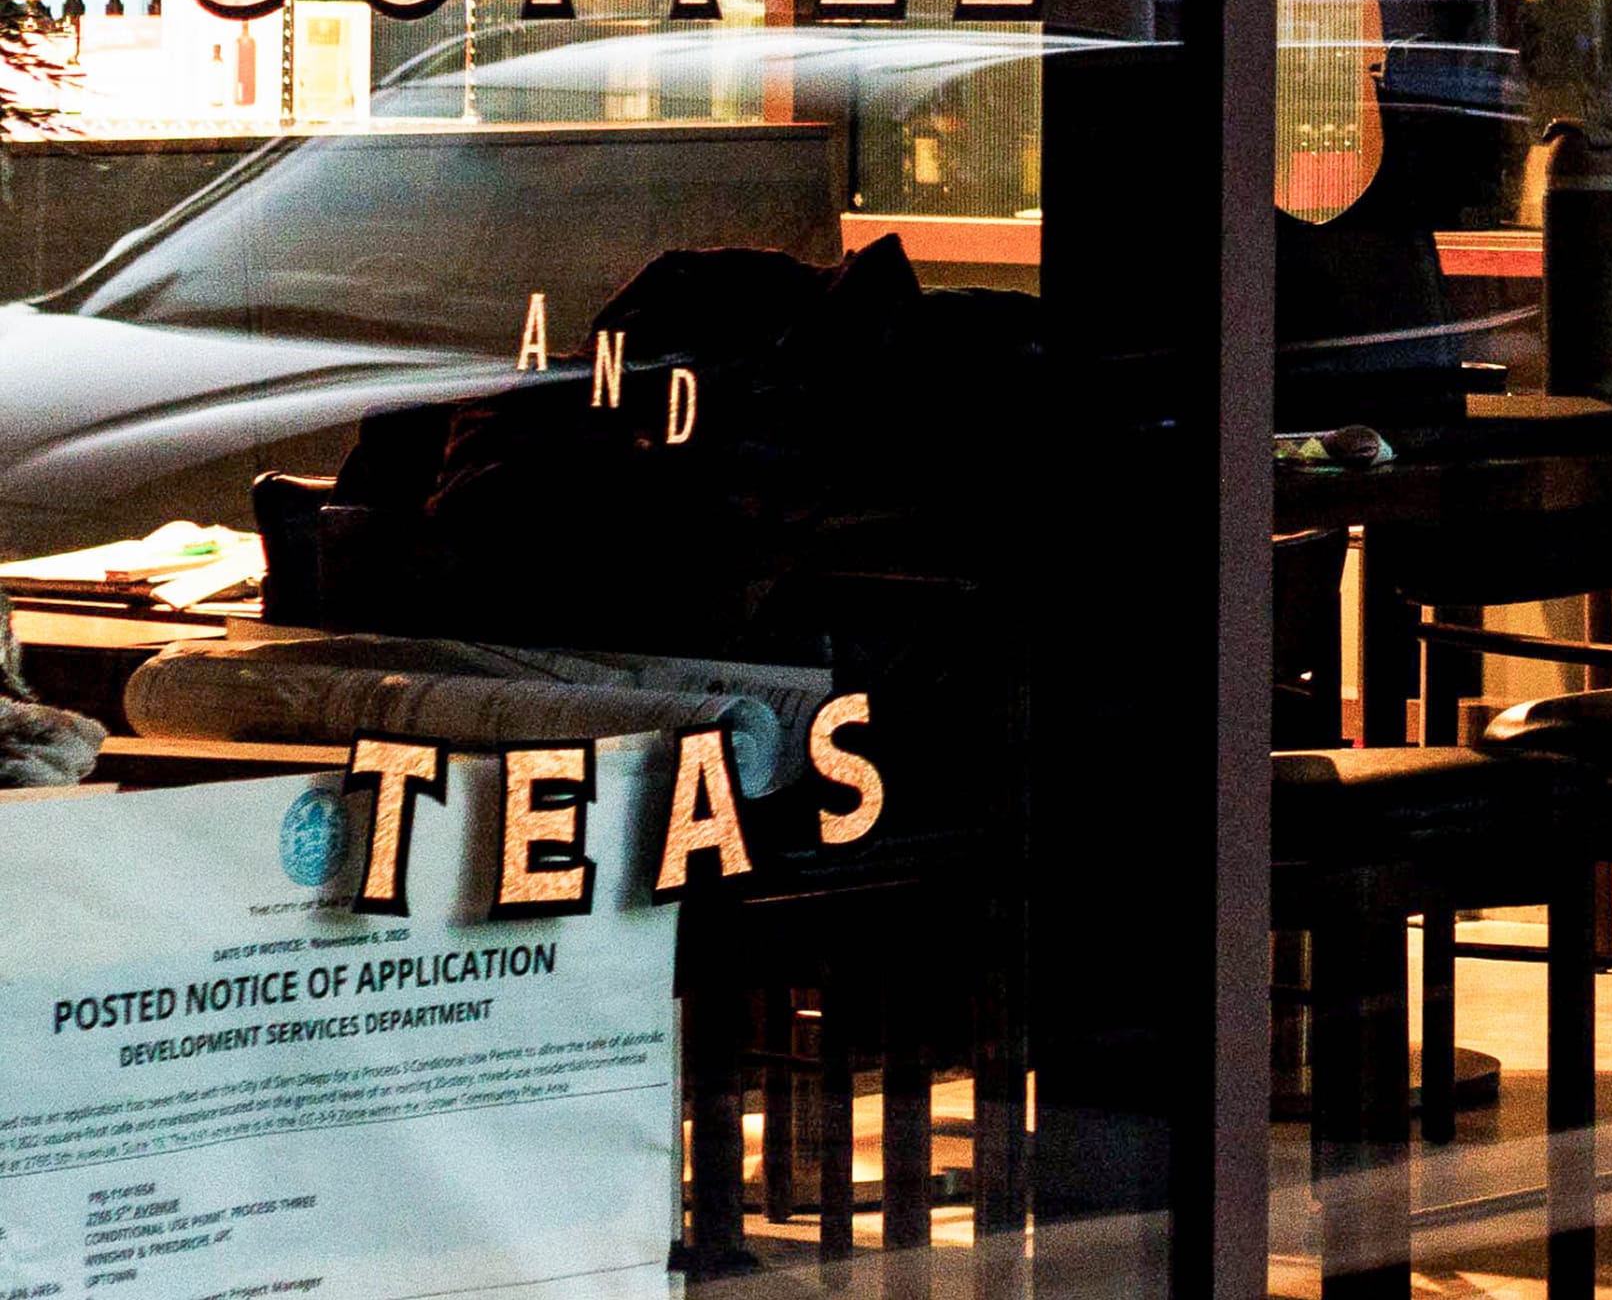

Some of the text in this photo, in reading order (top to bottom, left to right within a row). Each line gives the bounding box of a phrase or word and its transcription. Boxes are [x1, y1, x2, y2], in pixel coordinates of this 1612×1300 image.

[516, 293, 697, 444] AND
[344, 692, 885, 920] TEAS
[53, 942, 558, 1035] POSTED NOTICE OF APPLICATION
[119, 998, 494, 1068] DEVELOPMENT SERVICES DEPARTMENT
